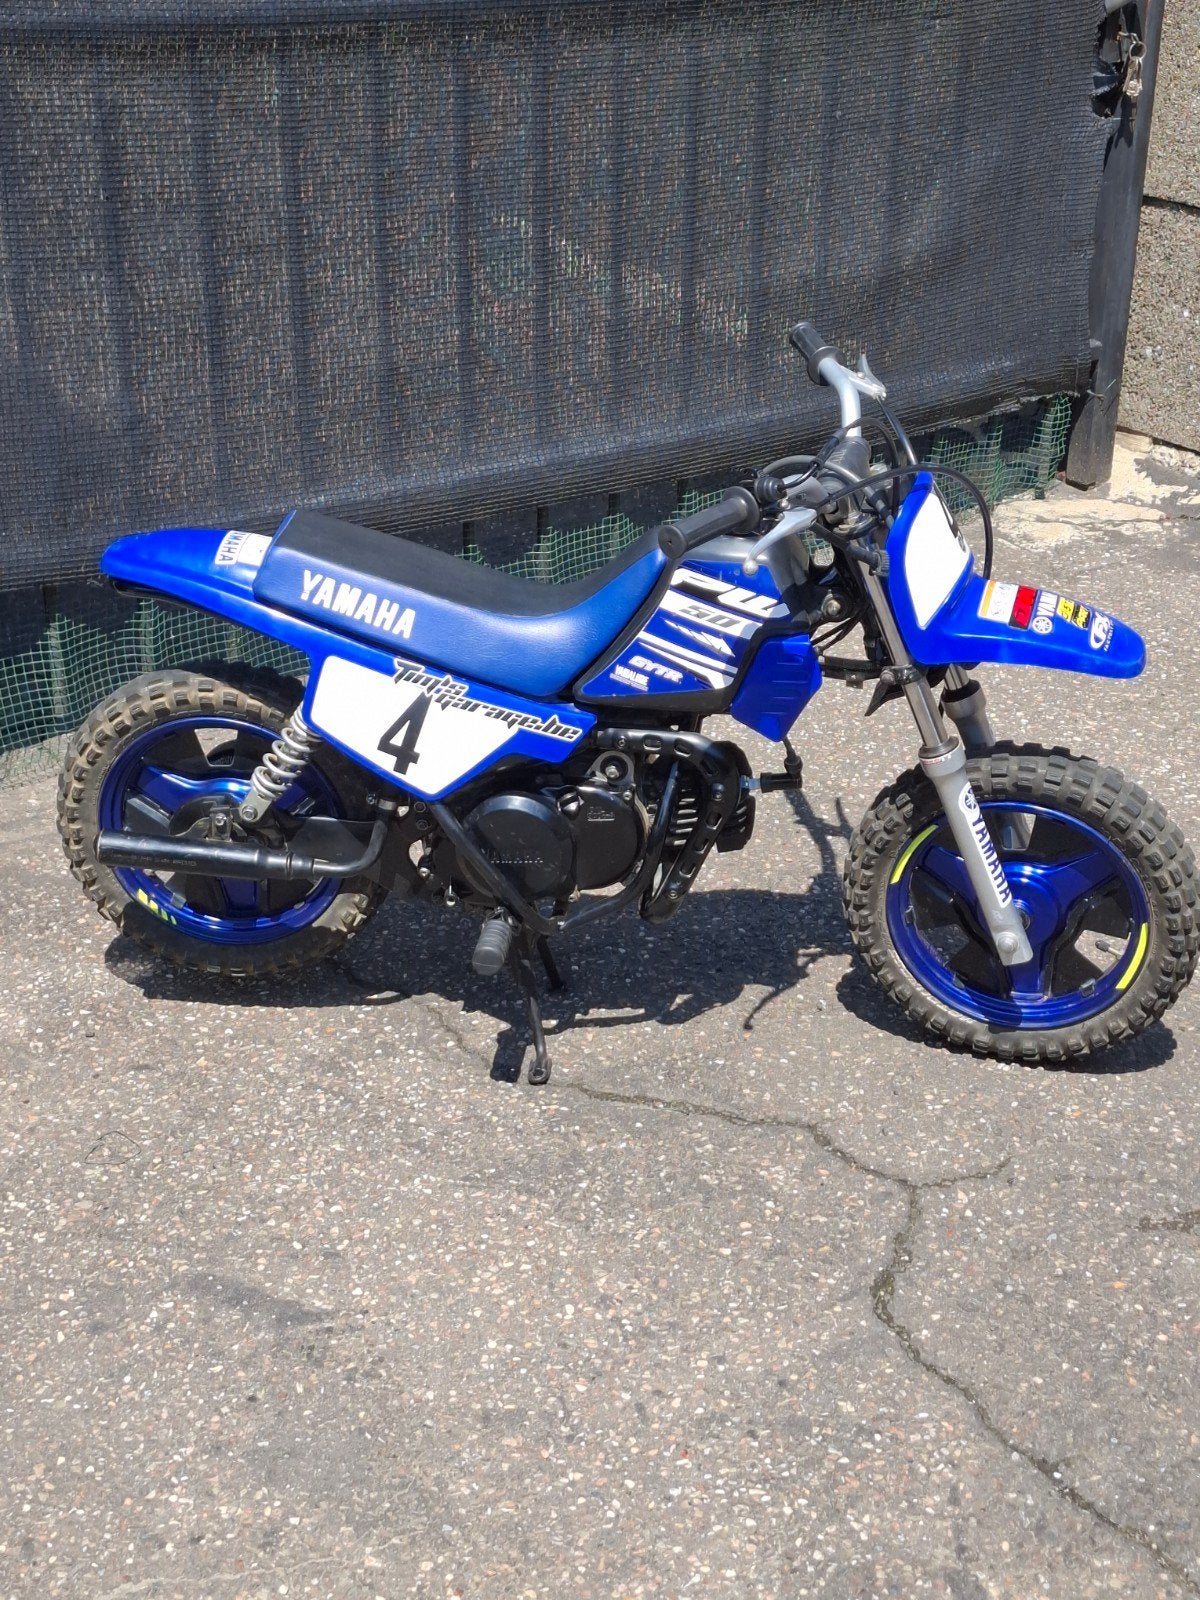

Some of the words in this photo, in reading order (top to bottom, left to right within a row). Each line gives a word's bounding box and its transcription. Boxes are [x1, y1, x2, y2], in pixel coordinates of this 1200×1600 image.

[300, 569, 416, 639] YAMAHA
[678, 604, 742, 628] 50
[393, 658, 468, 695] Tim's
[629, 655, 683, 683] GYTR
[377, 691, 433, 776] 4
[972, 813, 1013, 904] YAMAHA
